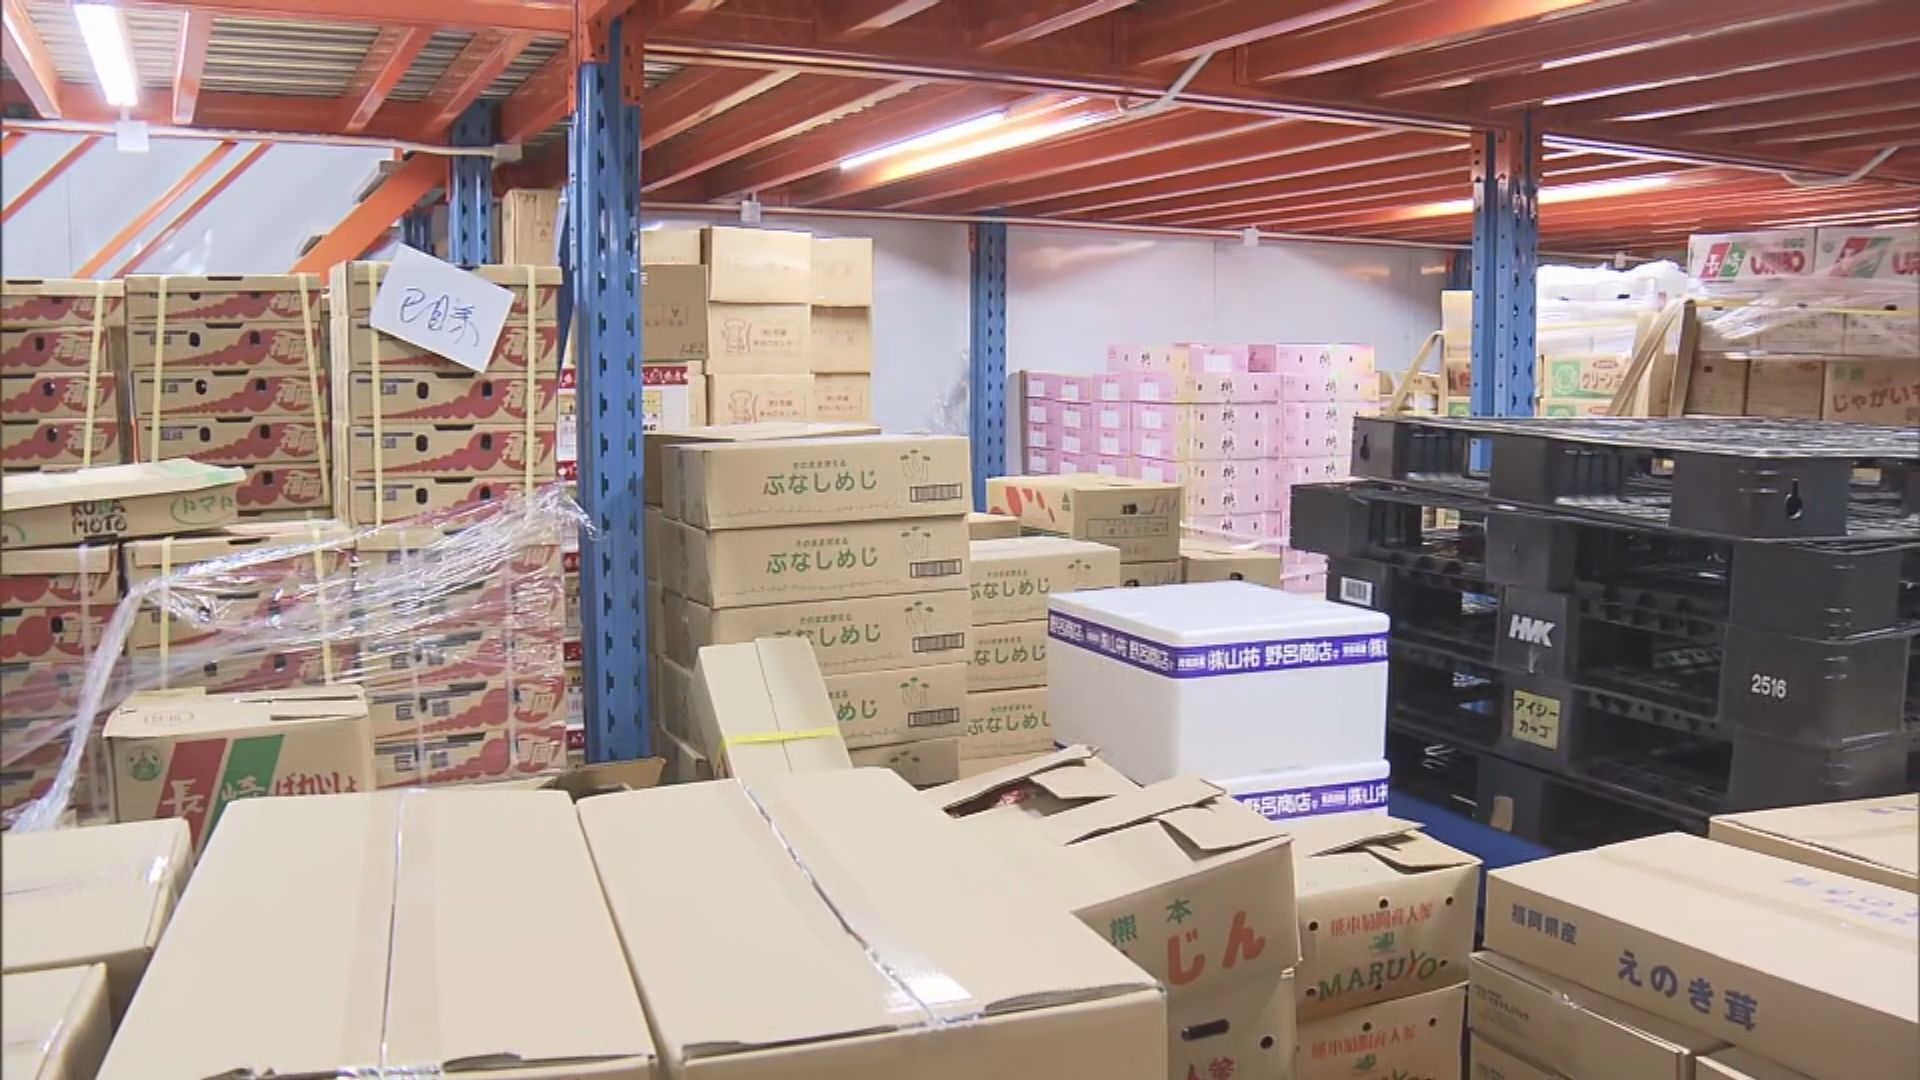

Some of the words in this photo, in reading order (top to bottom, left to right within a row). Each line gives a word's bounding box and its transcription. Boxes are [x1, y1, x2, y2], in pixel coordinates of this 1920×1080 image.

[763, 470, 878, 495] ぶなしめじ
[766, 547, 879, 574] ぶなしめじ
[1509, 614, 1556, 648] HMK
[967, 644, 1046, 666] なしめじ
[1265, 641, 1332, 666] 野呂商店
[1110, 899, 1192, 945] 熊本
[1512, 903, 1577, 945] 福岡県産
[1318, 949, 1437, 1001] MARUYO
[1618, 950, 1757, 1031] えのき茸
